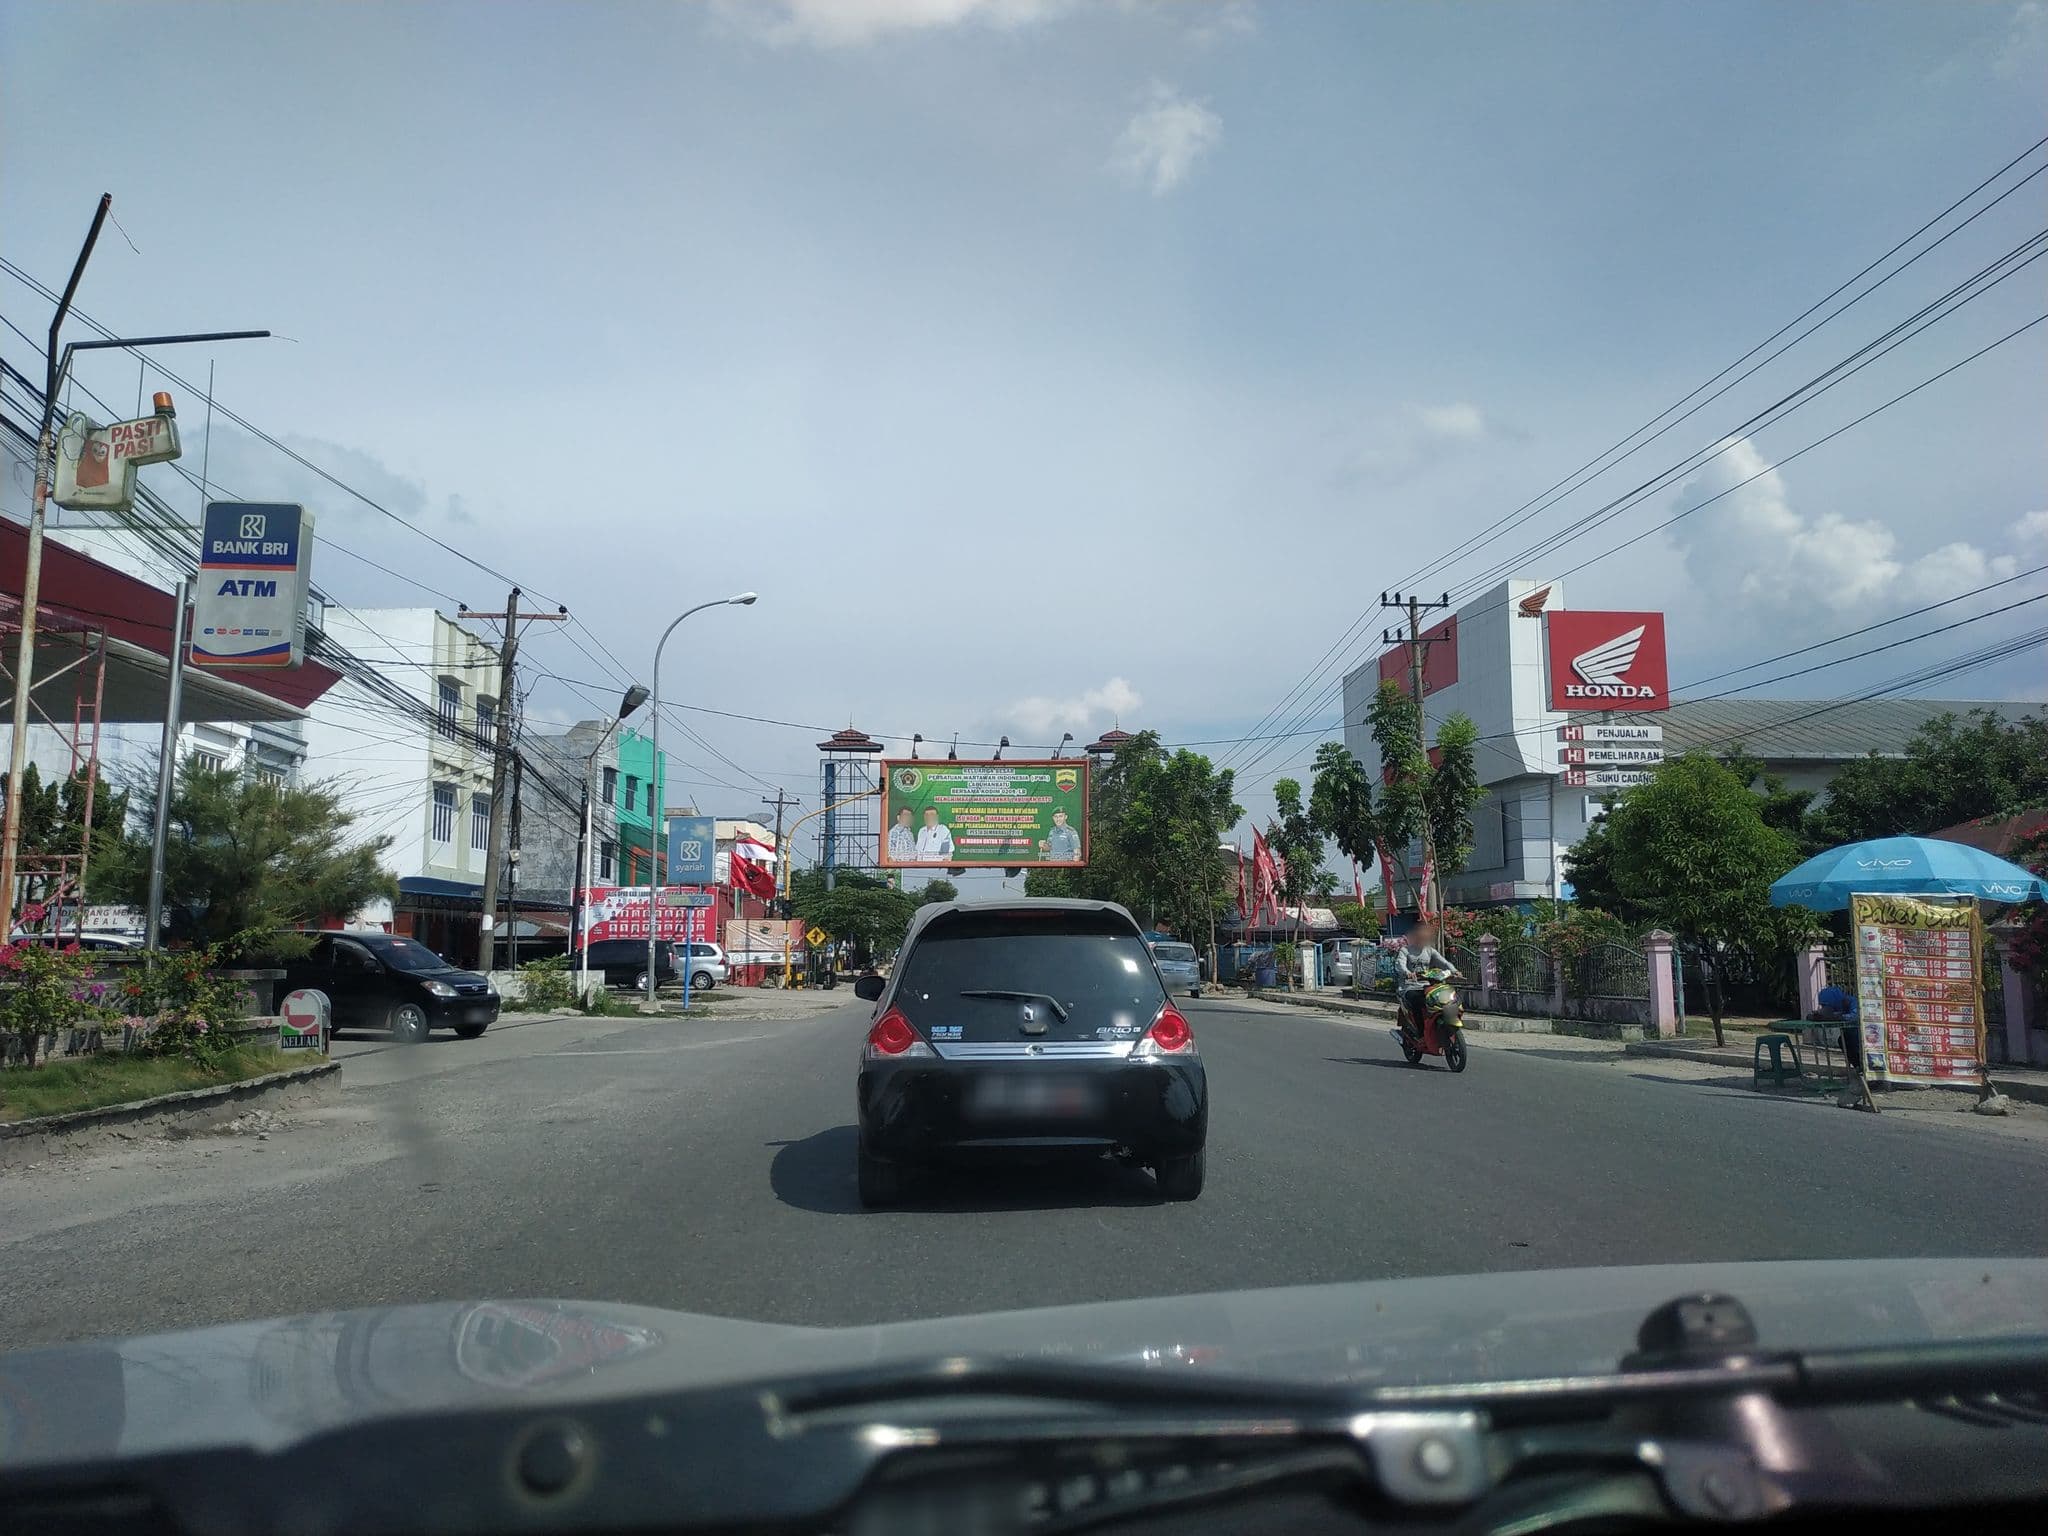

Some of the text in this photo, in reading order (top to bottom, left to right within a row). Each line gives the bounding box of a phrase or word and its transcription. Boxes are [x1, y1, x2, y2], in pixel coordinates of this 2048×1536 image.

[111, 420, 161, 443] PASTI
[213, 541, 288, 555] BANK BRI
[217, 580, 277, 597] ATM
[1566, 685, 1656, 697] HONDA
[1566, 727, 1649, 739] H1 PENJUALAN
[1568, 750, 1660, 761] H2 PEMELIHARAAN
[1622, 775, 1656, 783] CADANG
[675, 863, 705, 873] syariah
[283, 1036, 319, 1048] KELUAR
